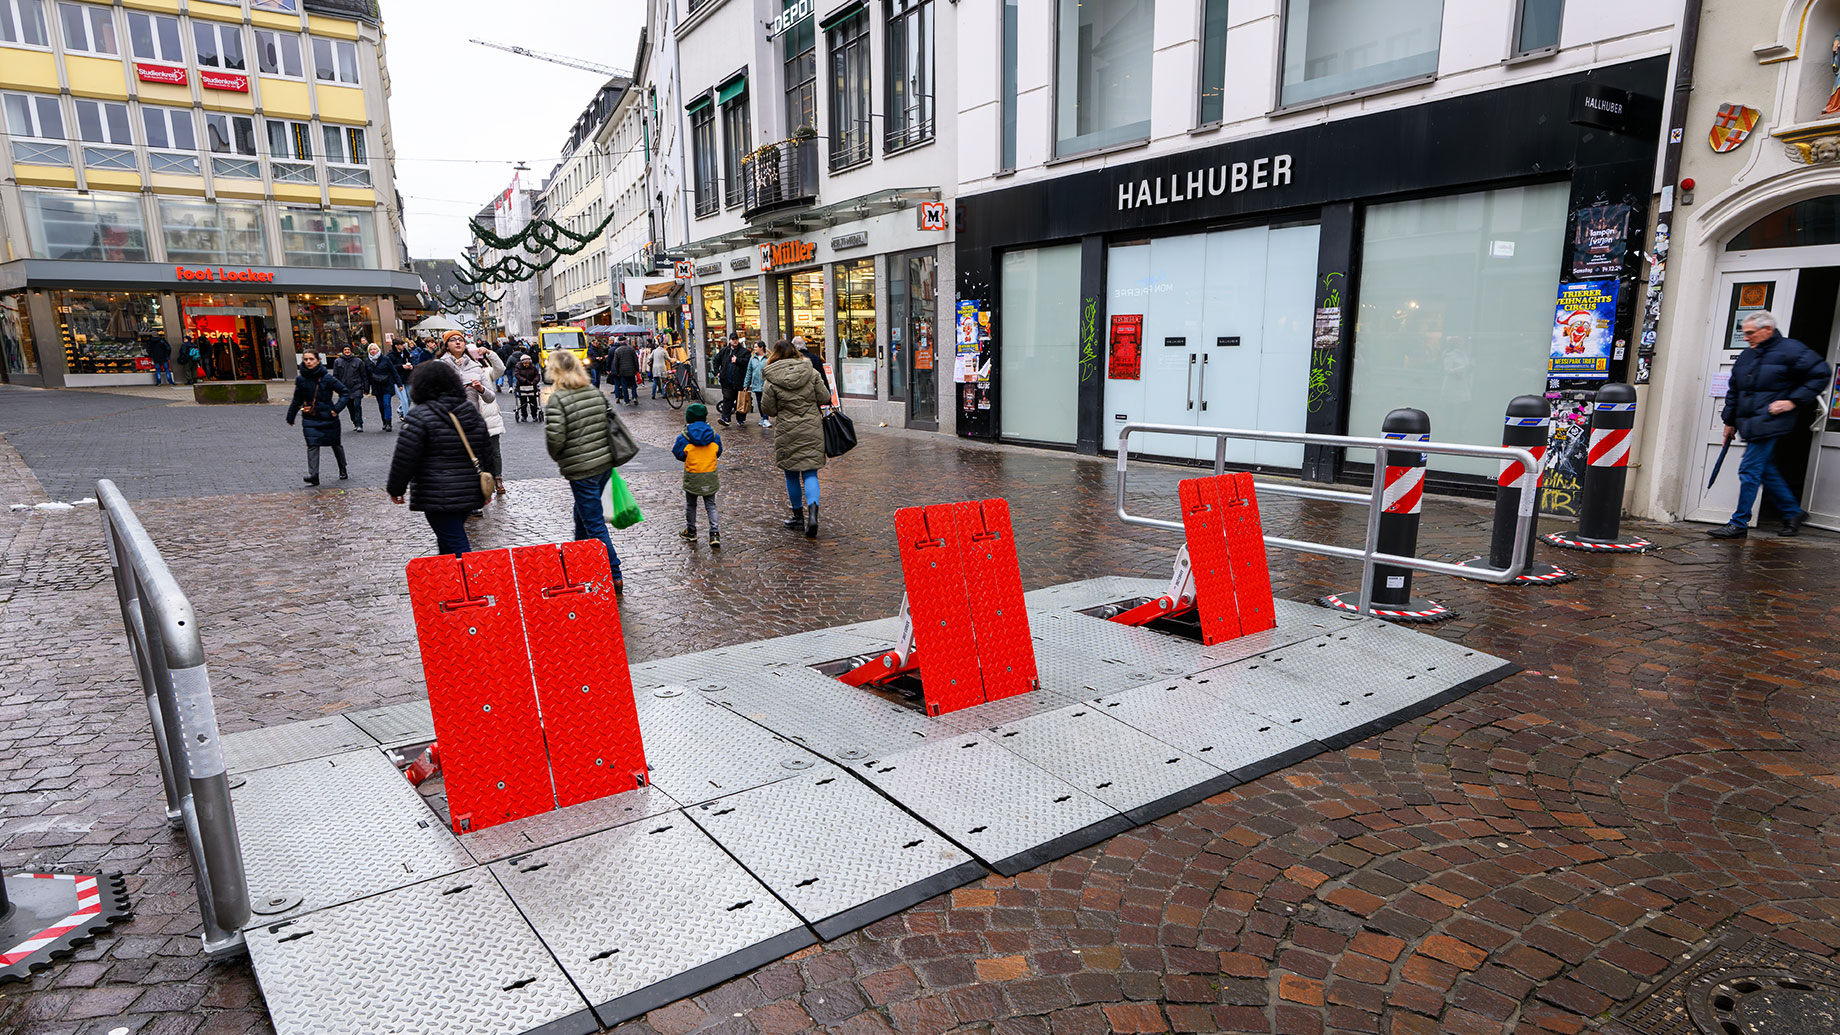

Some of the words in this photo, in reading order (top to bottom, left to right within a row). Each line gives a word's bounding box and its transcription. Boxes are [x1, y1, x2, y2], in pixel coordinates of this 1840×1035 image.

[1584, 96, 1623, 114] HALLHUBER
[1118, 154, 1292, 210] HALLHUBER
[927, 210, 939, 222] M
[771, 239, 814, 267] Müller
[176, 266, 214, 281] Foot
[219, 267, 274, 282] Locker
[679, 265, 688, 273] M
[1562, 289, 1602, 298] TRIERER
[1564, 303, 1597, 311] CIRCUS
